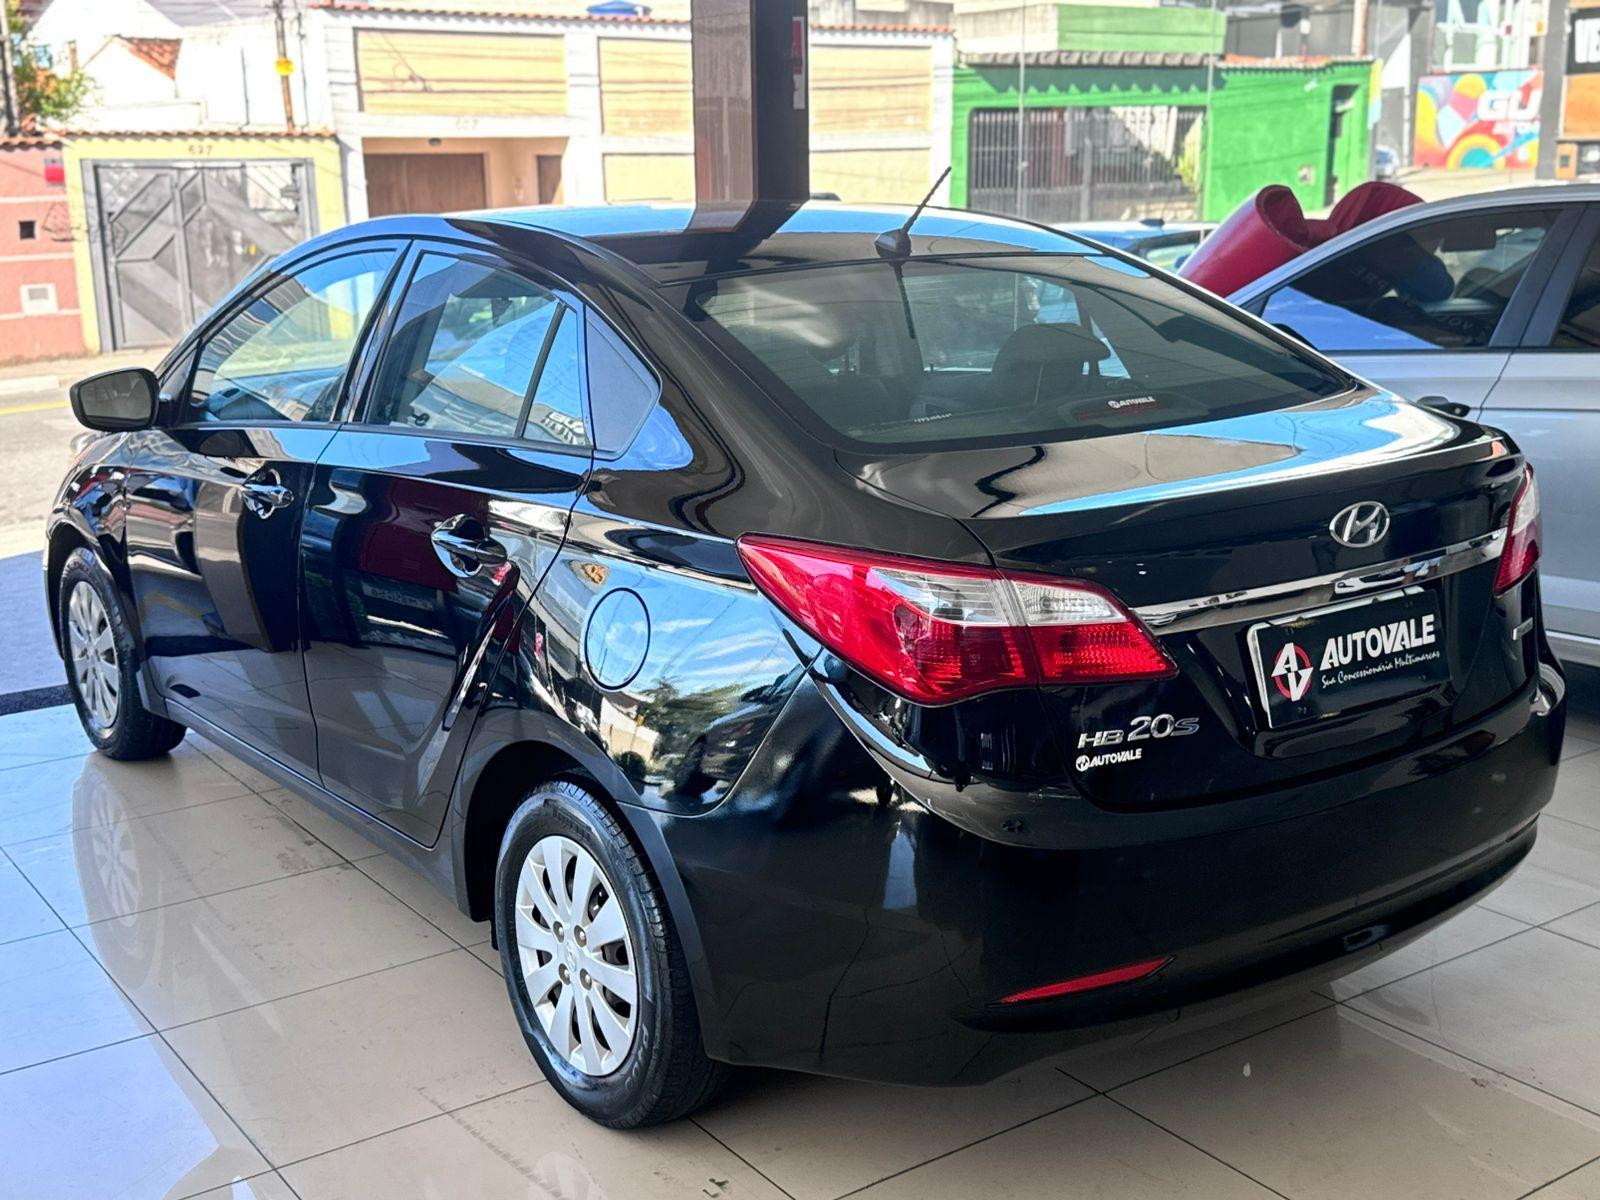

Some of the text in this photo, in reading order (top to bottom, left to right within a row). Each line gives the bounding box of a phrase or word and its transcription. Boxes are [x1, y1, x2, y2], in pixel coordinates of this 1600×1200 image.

[1319, 613, 1436, 672] AUTOVALE
[1321, 674, 1336, 689] Sua
[1394, 653, 1440, 669] Multimarcas
[1089, 748, 1143, 768] AUTOVALE
